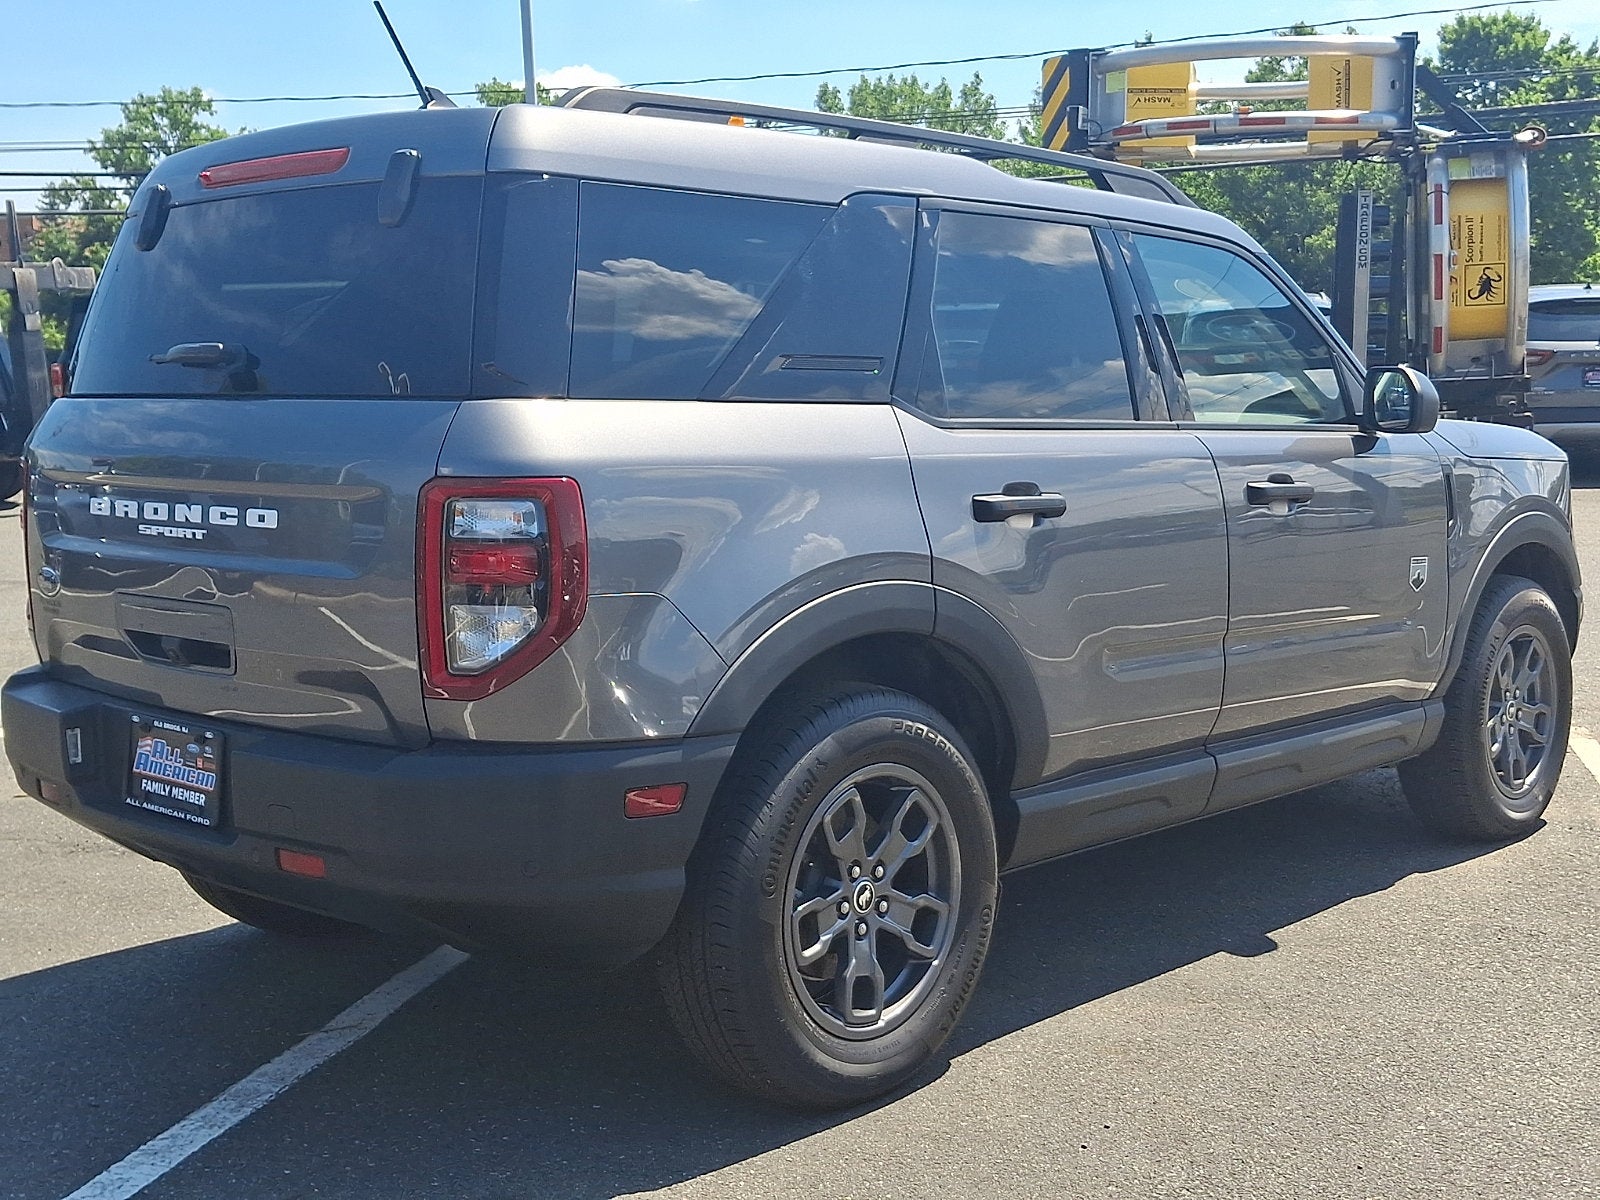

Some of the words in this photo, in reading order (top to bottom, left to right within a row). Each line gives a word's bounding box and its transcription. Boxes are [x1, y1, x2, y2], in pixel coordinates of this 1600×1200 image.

[1144, 96, 1171, 104] MASH
[1465, 224, 1475, 263] Scorpion
[89, 497, 278, 529] BRONCO
[138, 524, 207, 540] SPORT
[141, 778, 170, 797] FAMILY
[171, 786, 206, 807] MEMBER
[125, 797, 140, 807] ALL
[142, 801, 185, 819] AMERICAN
[186, 813, 210, 826] FORD
[761, 767, 820, 899] Continental
